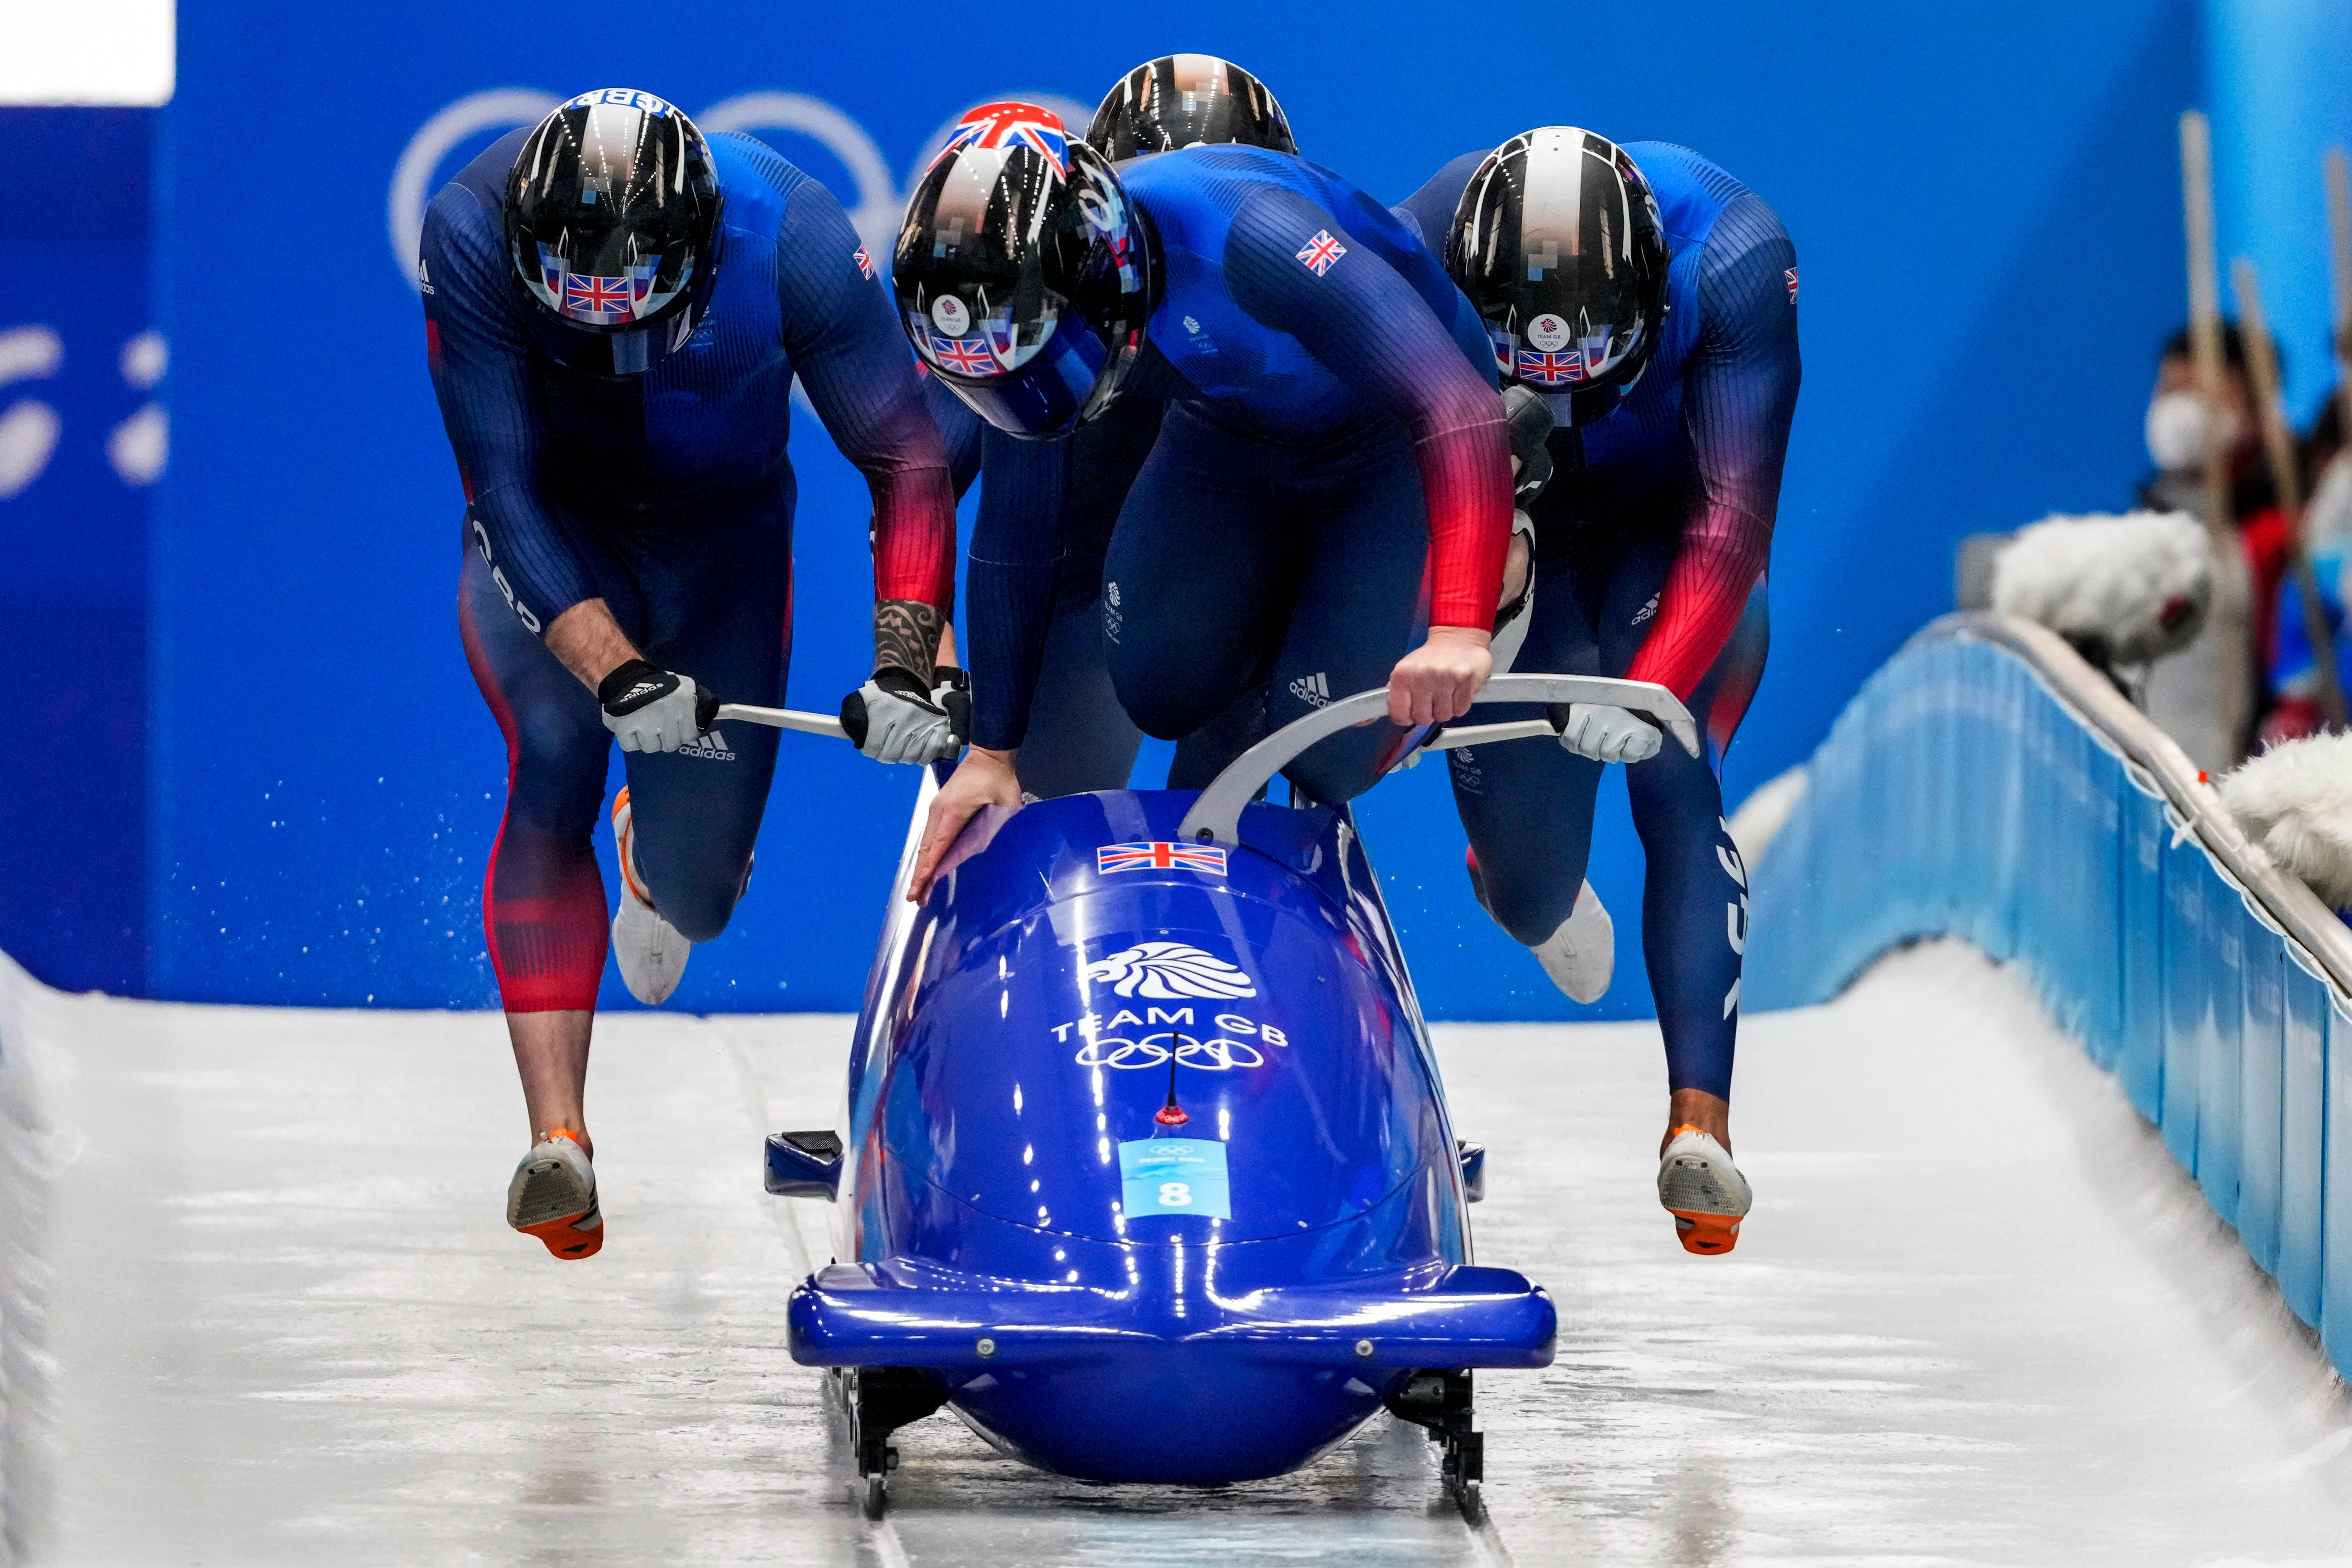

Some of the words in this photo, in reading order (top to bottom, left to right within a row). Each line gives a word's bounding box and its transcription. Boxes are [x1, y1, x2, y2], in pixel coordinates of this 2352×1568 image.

[576, 89, 664, 113] GBR
[1105, 600, 1115, 616] TEAM
[1115, 612, 1123, 622] GB
[1631, 607, 1657, 625] adi
[620, 683, 664, 702] adidas
[679, 746, 736, 761] adidas
[1051, 1007, 1194, 1043] TEAM
[1214, 1013, 1289, 1047] GB
[1158, 1182, 1192, 1206] 8
